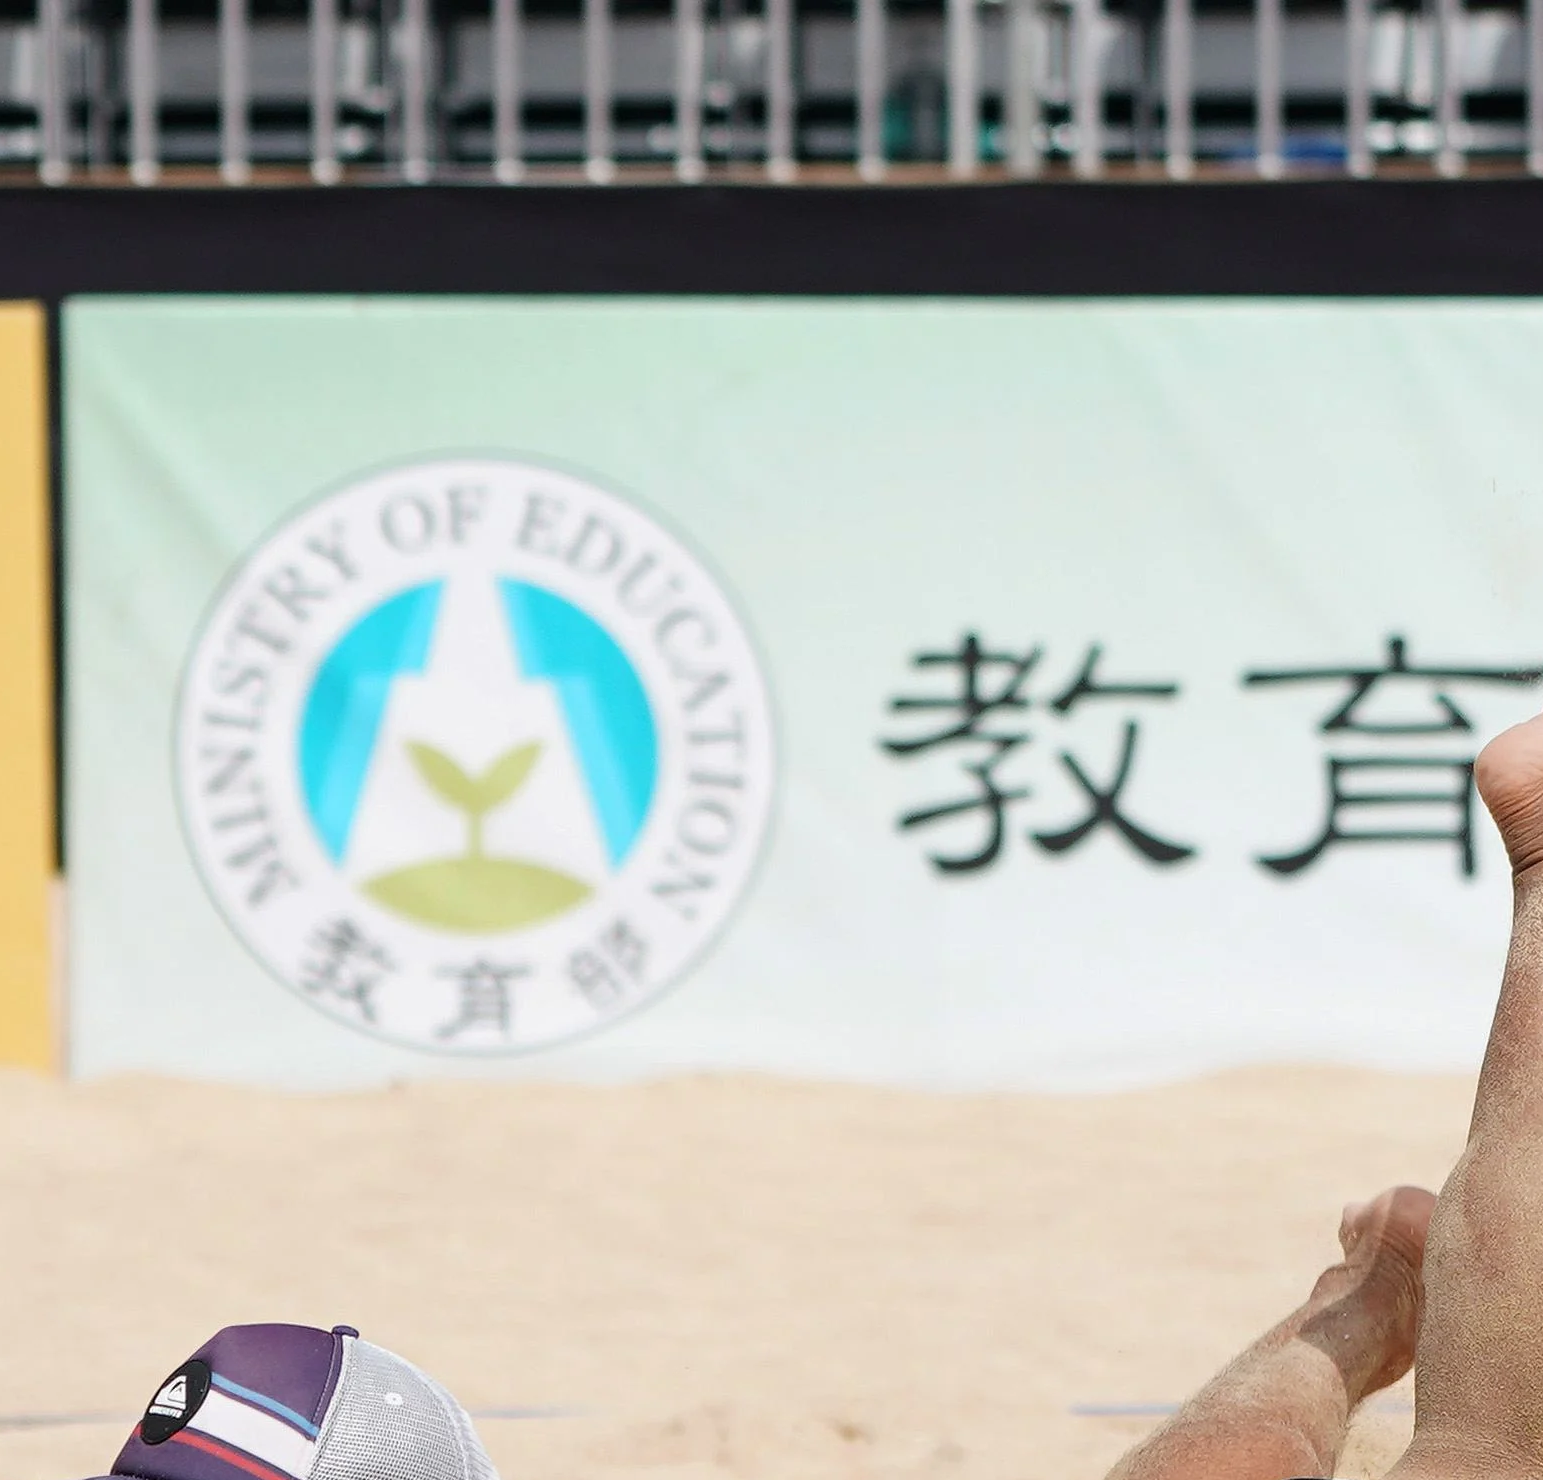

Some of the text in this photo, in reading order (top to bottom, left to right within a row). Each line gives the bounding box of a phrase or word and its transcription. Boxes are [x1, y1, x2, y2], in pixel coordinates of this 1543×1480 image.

[200, 480, 750, 922] MINISTRY OF EDUCATION
[300, 914, 653, 1044] 教育部
